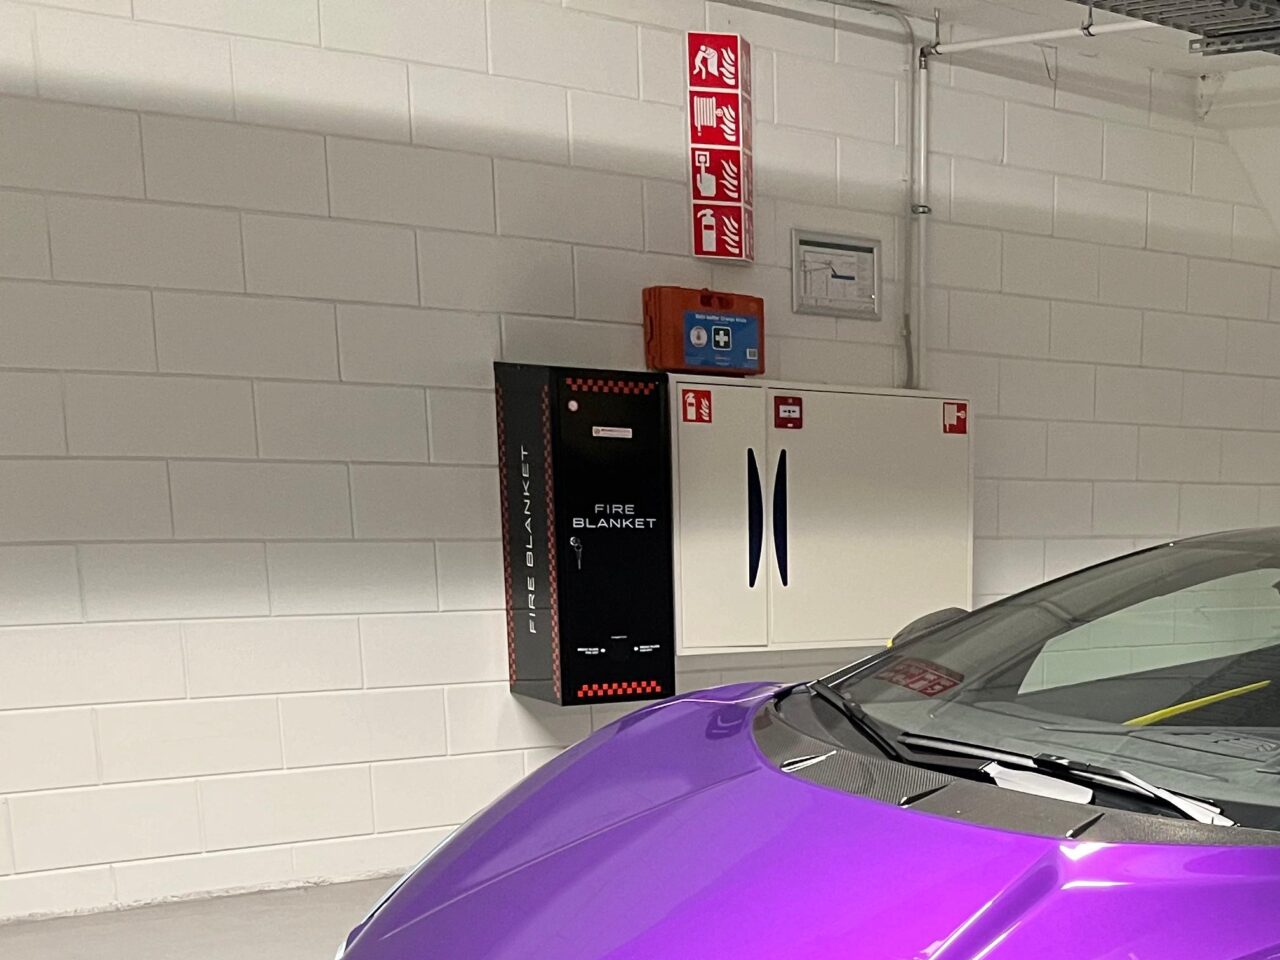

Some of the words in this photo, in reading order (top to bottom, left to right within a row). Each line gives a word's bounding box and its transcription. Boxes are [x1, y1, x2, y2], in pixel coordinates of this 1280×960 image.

[520, 445, 533, 568] BLANKET
[572, 517, 657, 529] BLANKET
[594, 503, 635, 515] FIRE
[527, 576, 537, 634] FIRE
